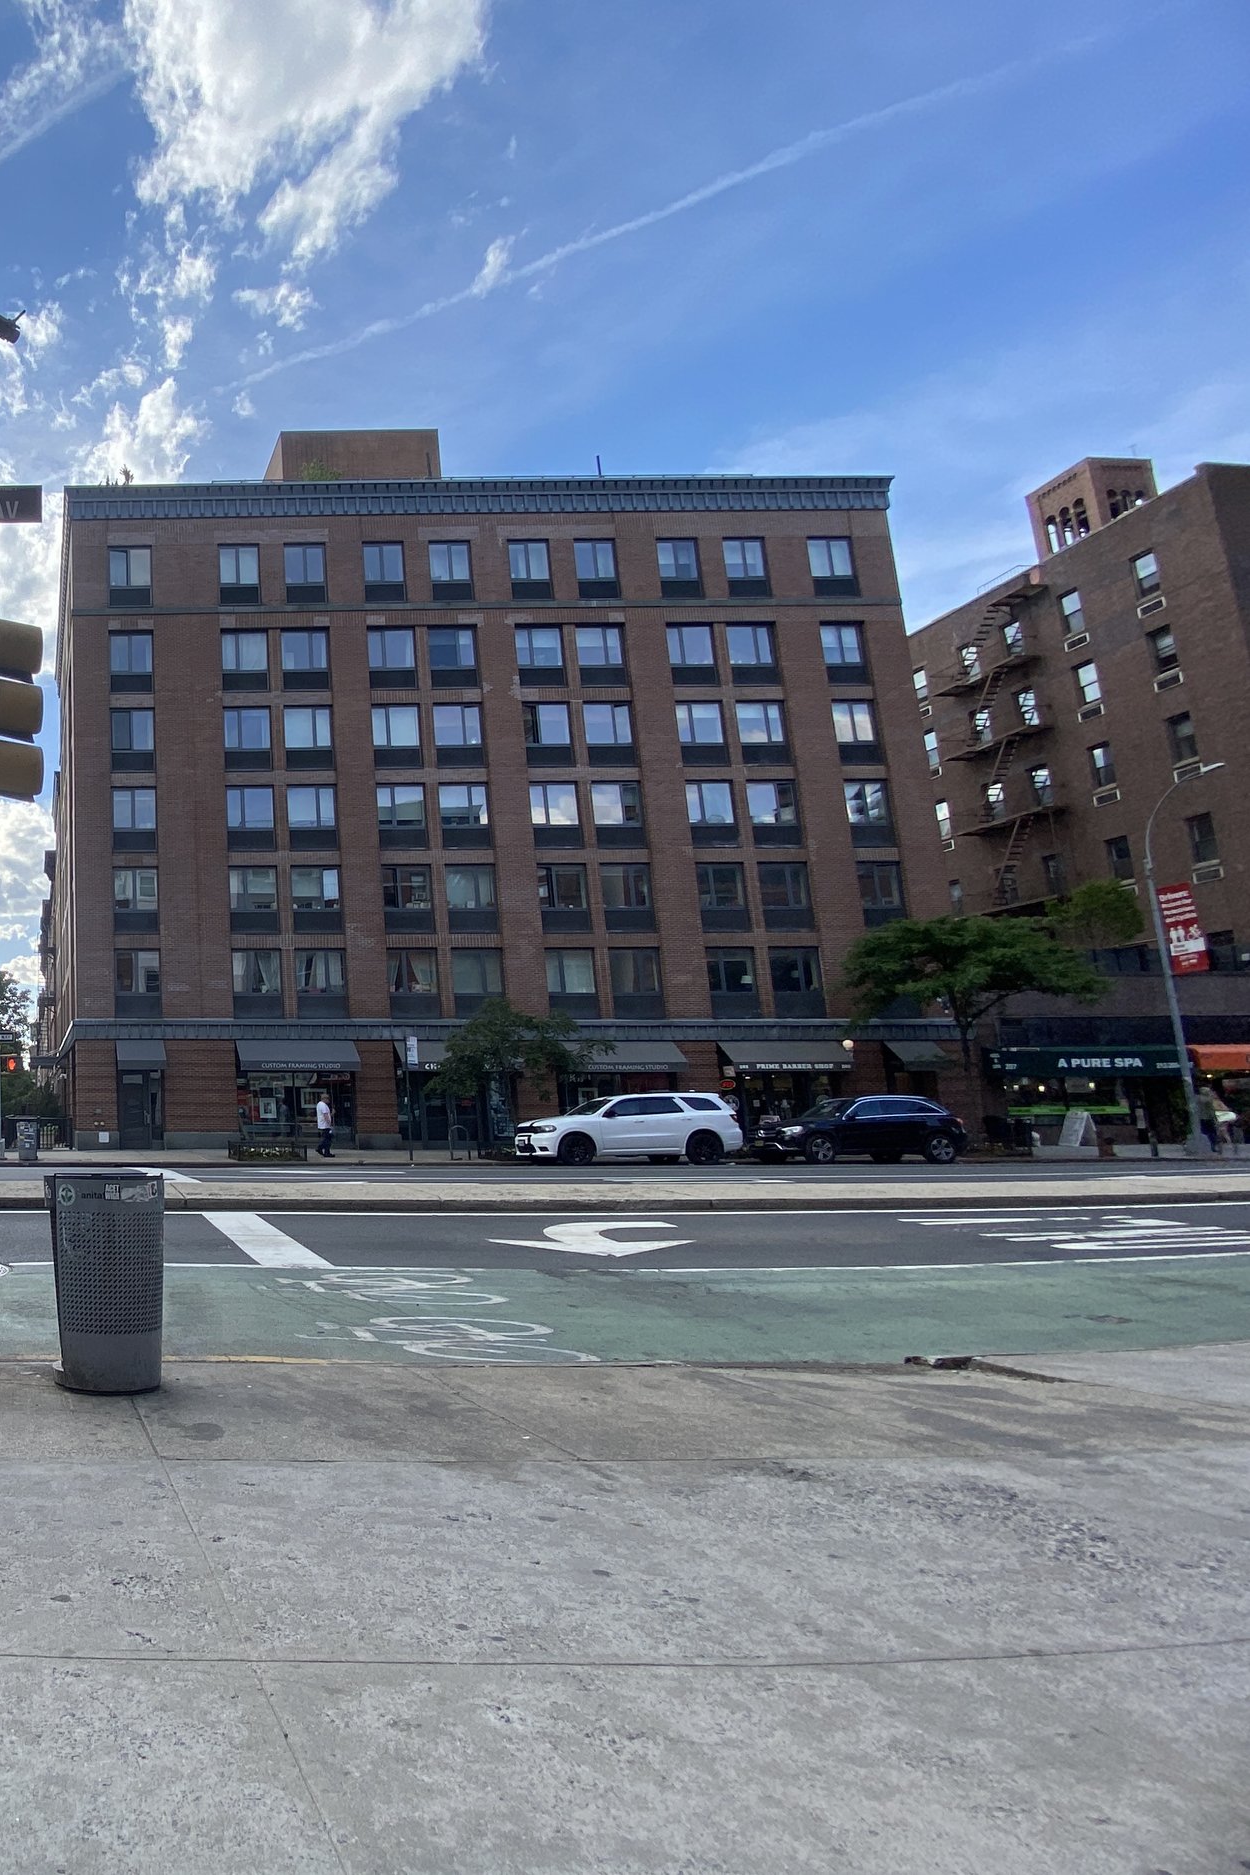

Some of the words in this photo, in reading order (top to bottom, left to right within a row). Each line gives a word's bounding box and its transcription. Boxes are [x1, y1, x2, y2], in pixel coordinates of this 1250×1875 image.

[1057, 1058, 1068, 1068] A
[1070, 1058, 1112, 1068] PURE
[1114, 1057, 1143, 1068] SPA
